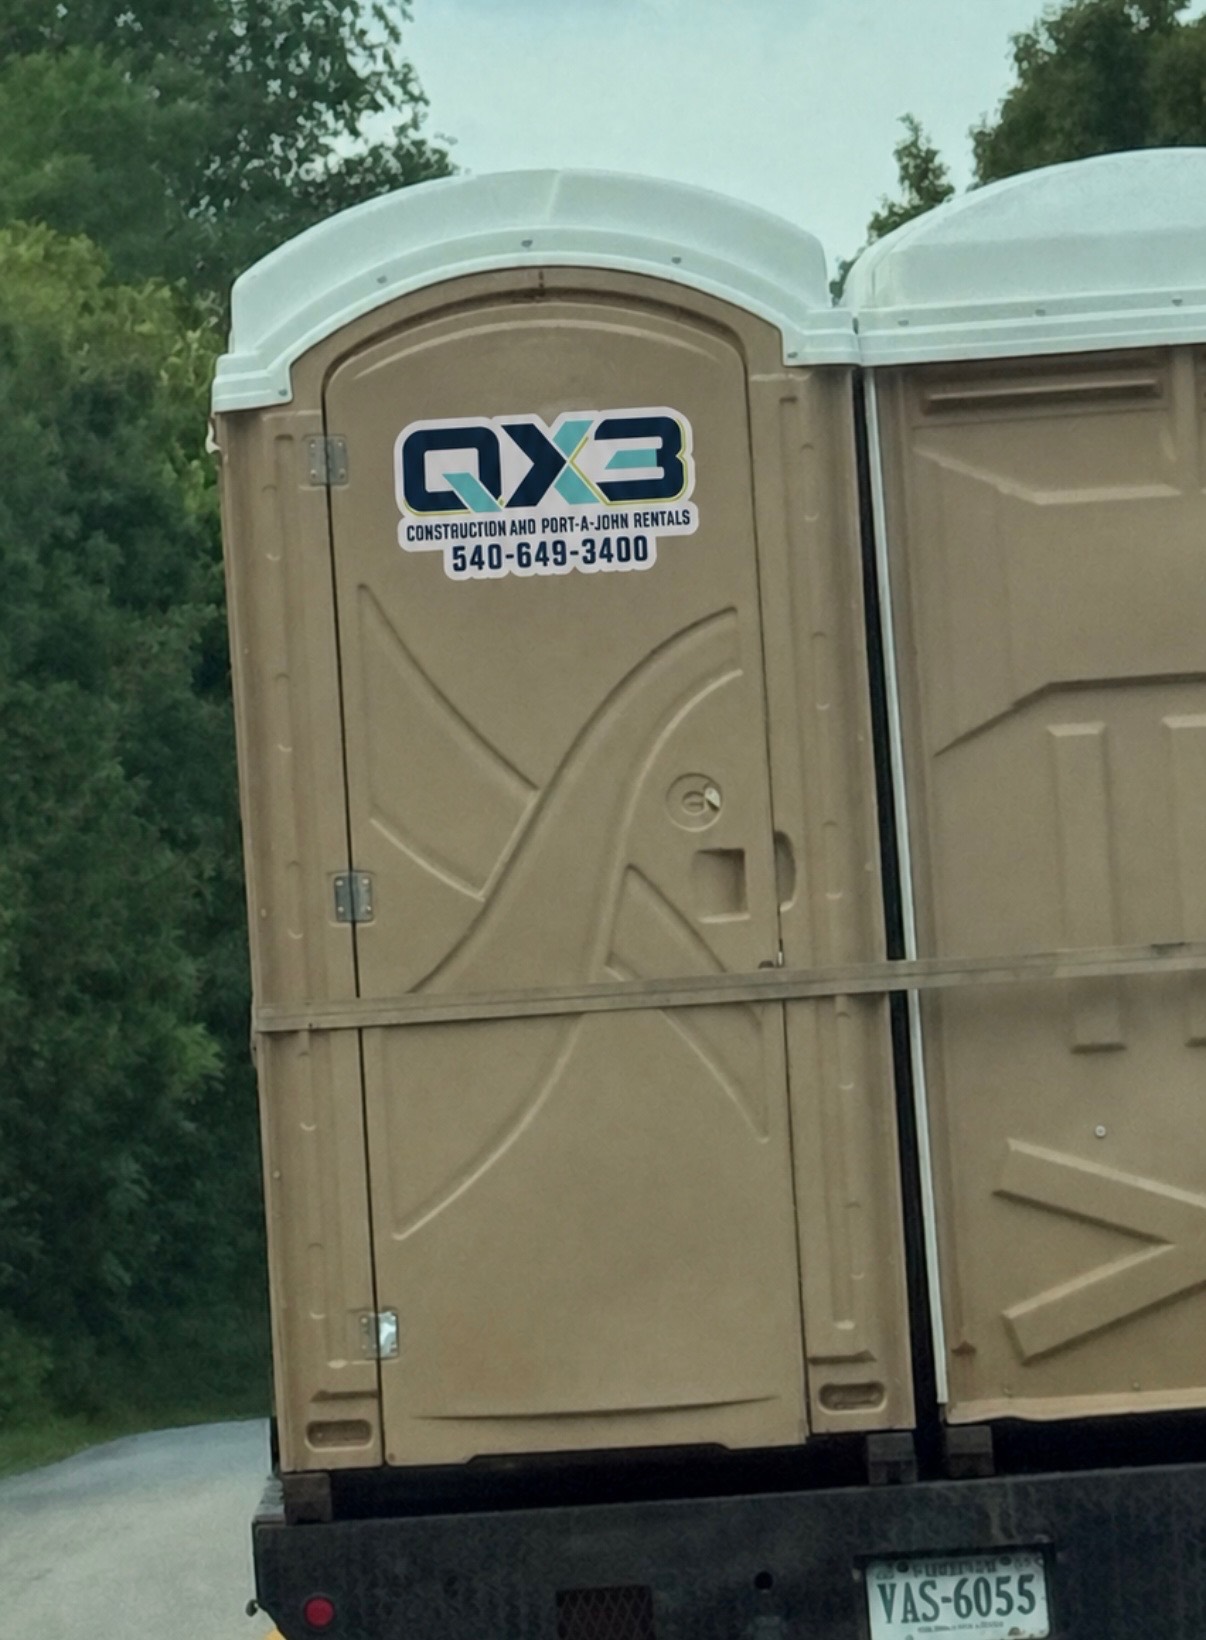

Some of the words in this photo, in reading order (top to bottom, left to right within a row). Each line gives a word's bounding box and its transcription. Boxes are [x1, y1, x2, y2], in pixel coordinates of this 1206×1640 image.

[402, 416, 688, 516] QX3
[407, 519, 506, 542] CONSTRUCTION
[542, 515, 629, 534] PORT-A-JOHN
[634, 509, 690, 528] RENTALS
[452, 535, 648, 572] 540-649-3400
[877, 1574, 1036, 1624] VAS-6055
